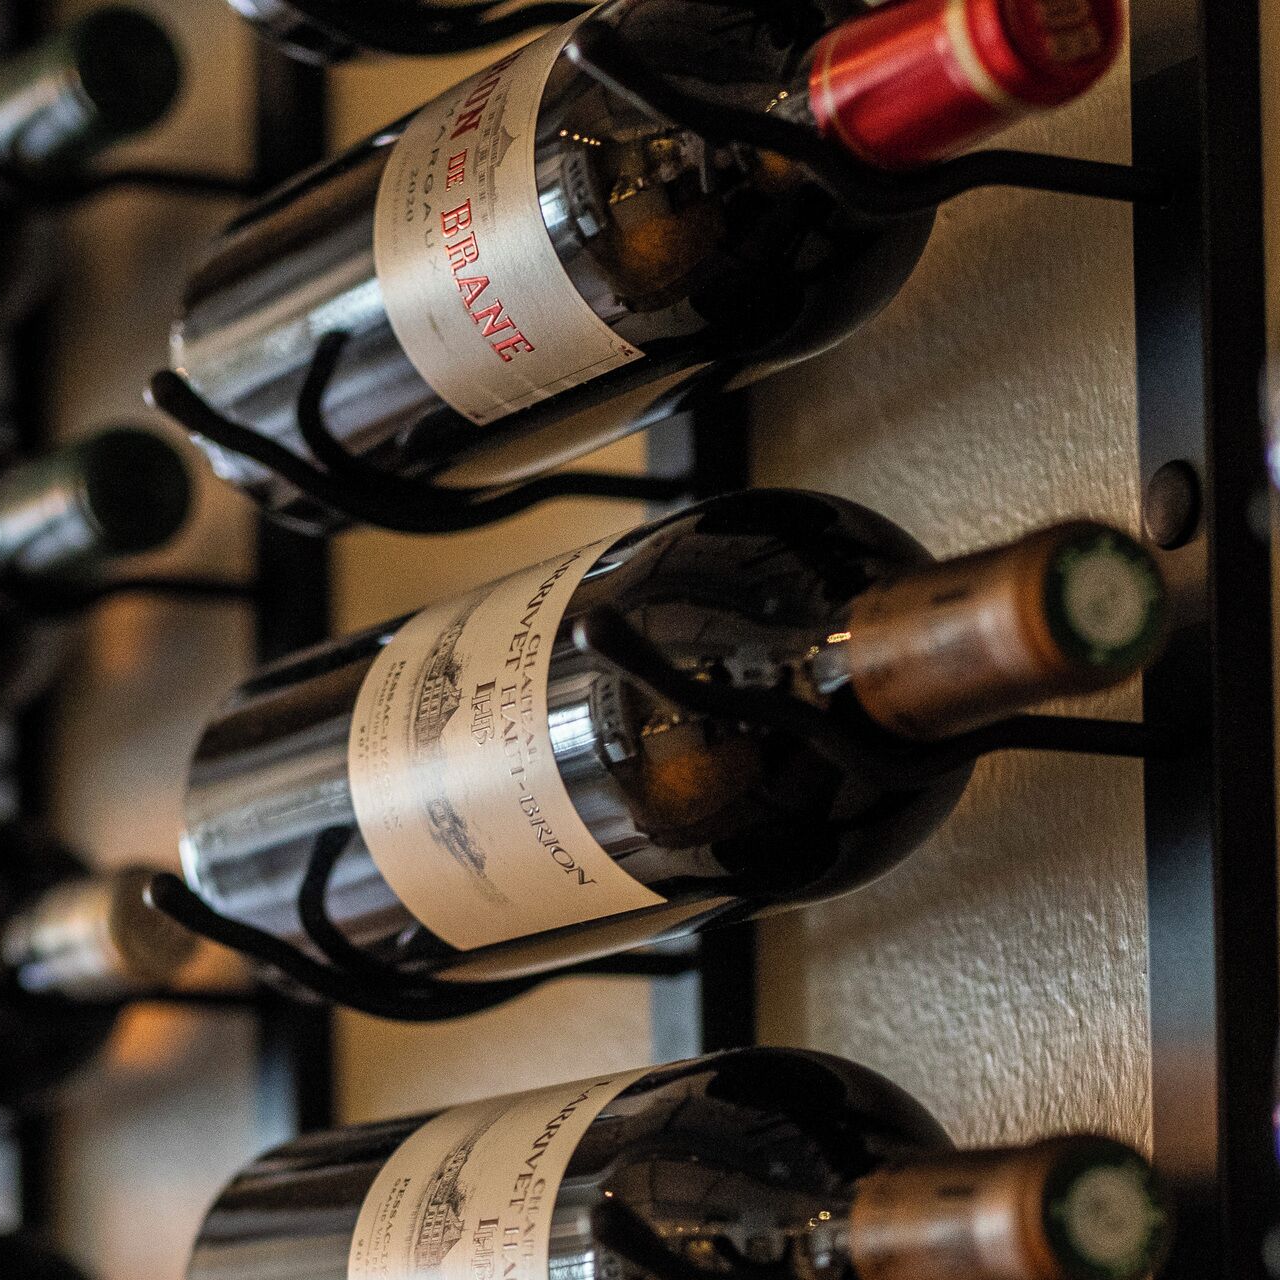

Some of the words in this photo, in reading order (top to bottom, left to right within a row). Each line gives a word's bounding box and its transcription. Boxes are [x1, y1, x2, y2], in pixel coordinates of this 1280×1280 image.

[446, 149, 468, 192] DE
[440, 198, 536, 363] BRANE
[500, 683, 597, 886] HAUT-BRION
